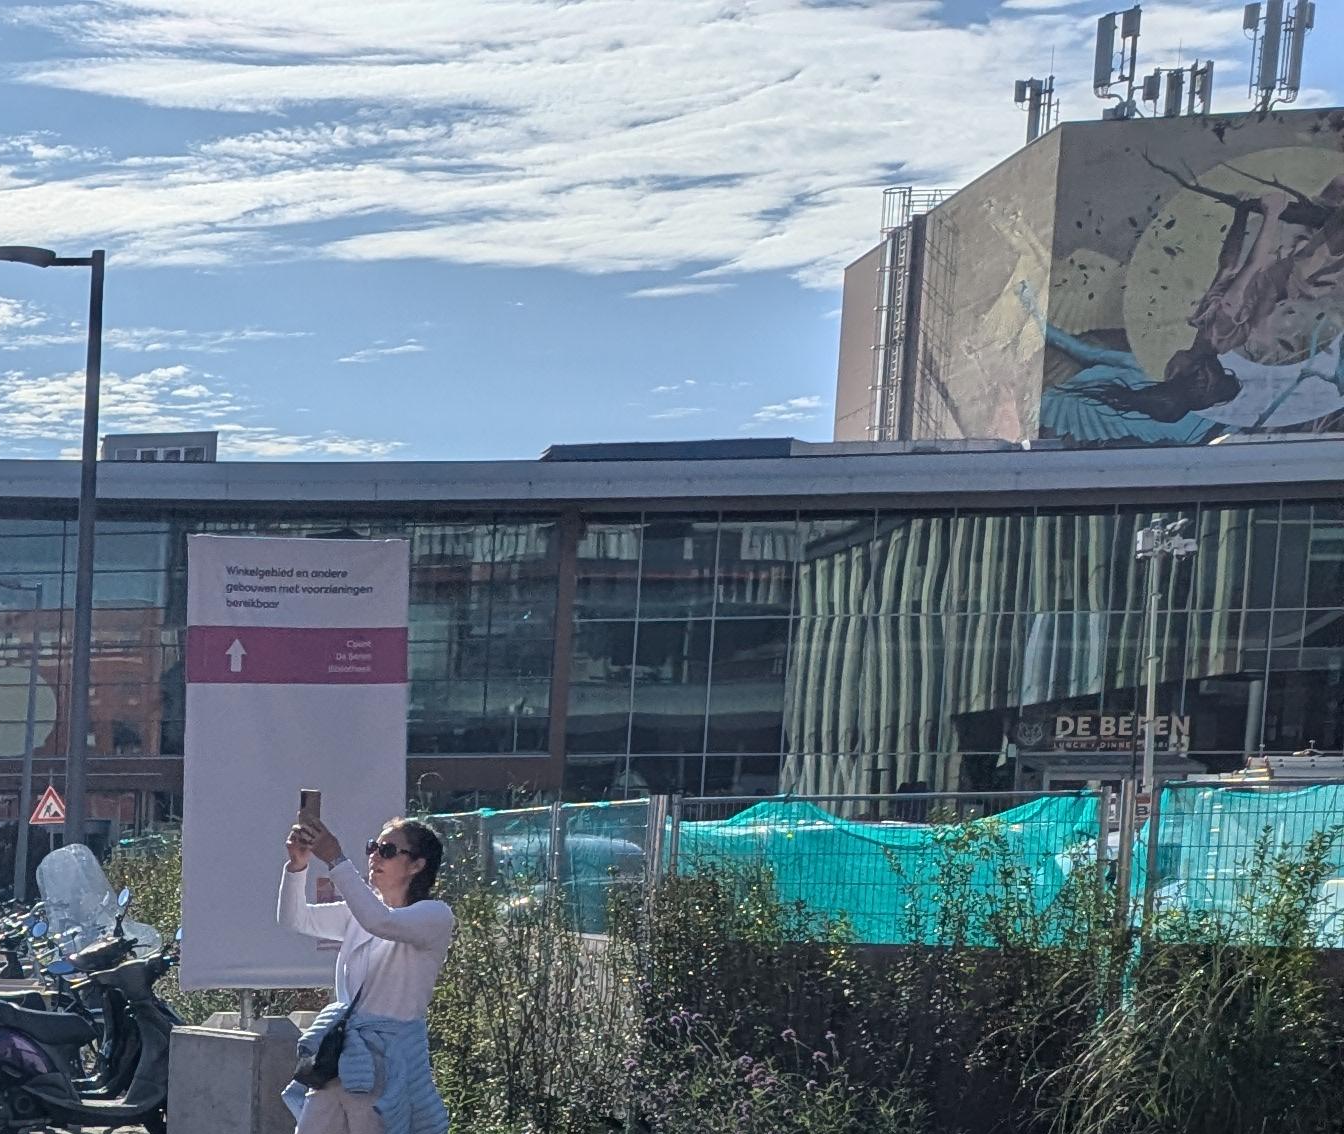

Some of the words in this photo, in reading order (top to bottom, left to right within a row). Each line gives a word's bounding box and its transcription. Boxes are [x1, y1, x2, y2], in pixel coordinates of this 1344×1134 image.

[225, 566, 294, 580] Winkelgebied
[296, 570, 309, 578] en
[311, 569, 349, 578] andere
[225, 582, 277, 594] gebouwen
[278, 584, 300, 594] met
[301, 584, 374, 596] voorzieningen
[225, 598, 280, 609] bereikbaar
[1055, 716, 1092, 736] DE
